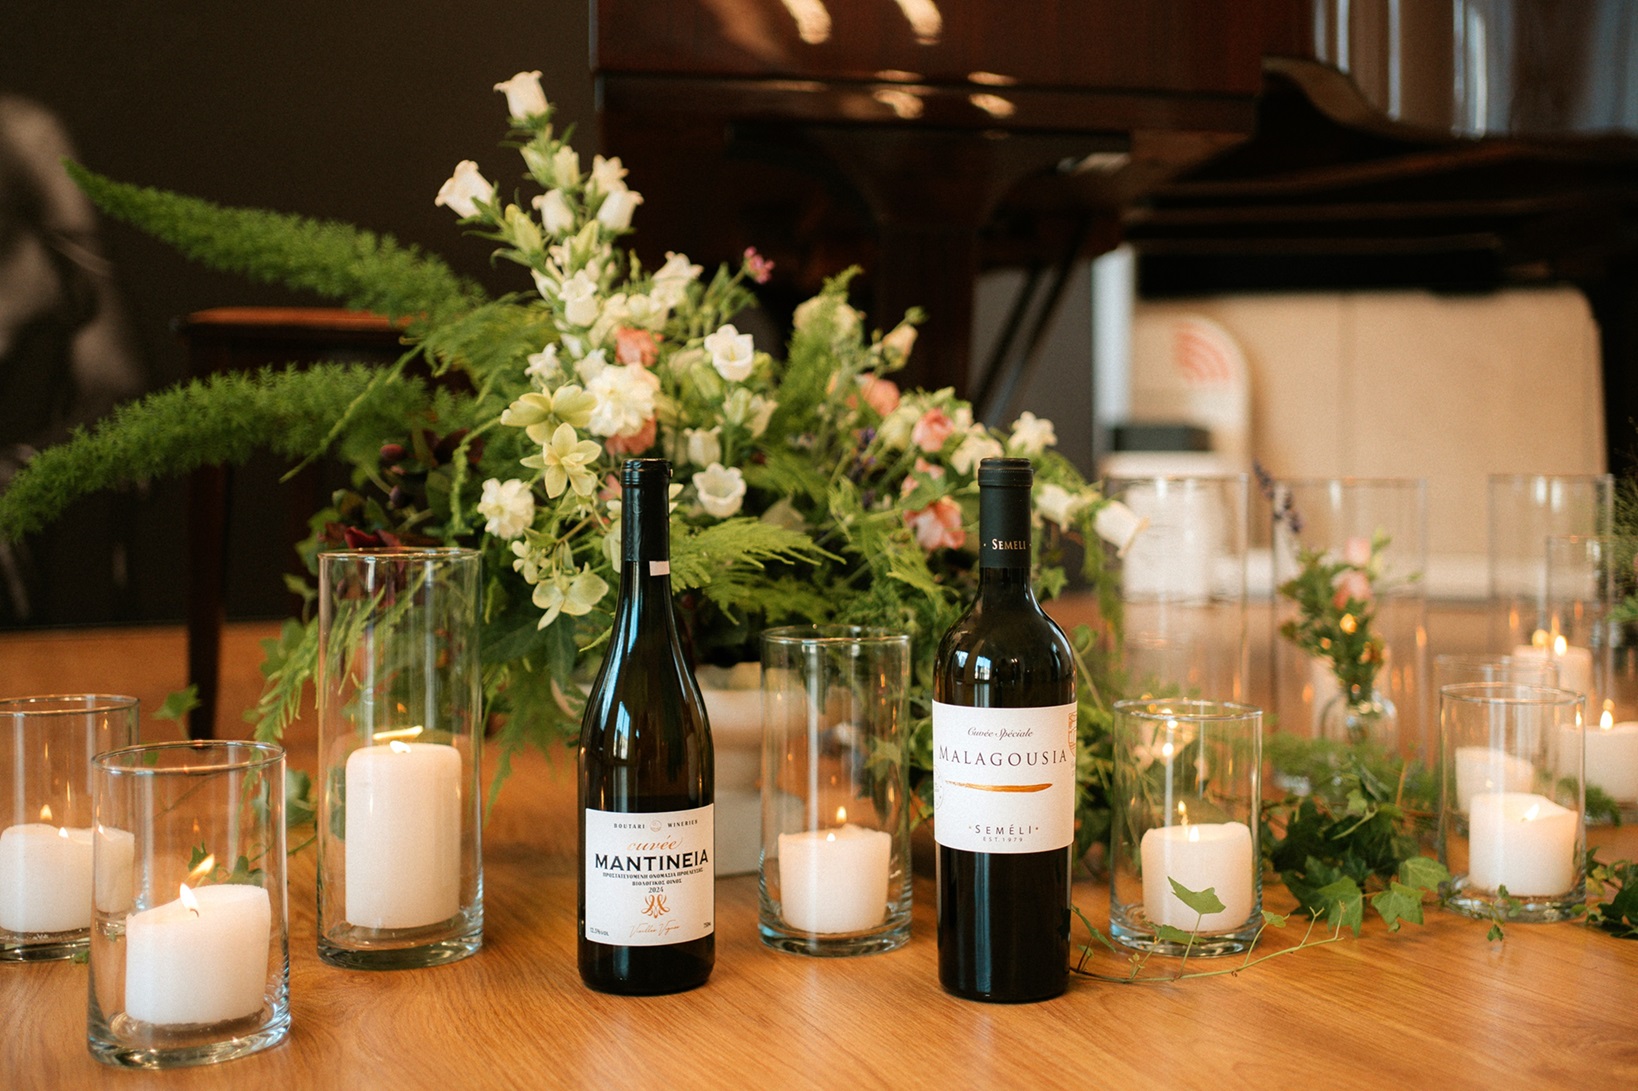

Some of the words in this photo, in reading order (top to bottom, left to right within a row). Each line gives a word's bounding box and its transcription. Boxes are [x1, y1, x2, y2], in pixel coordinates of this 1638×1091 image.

[991, 538, 1026, 550] SEMELI
[967, 727, 994, 737] Cuvée
[995, 727, 1033, 741] Spéciale
[939, 745, 1067, 767] MALAGOUSIA
[667, 819, 698, 828] WINERIES
[626, 834, 684, 851] cuvée
[595, 849, 708, 871] MANTINEIA
